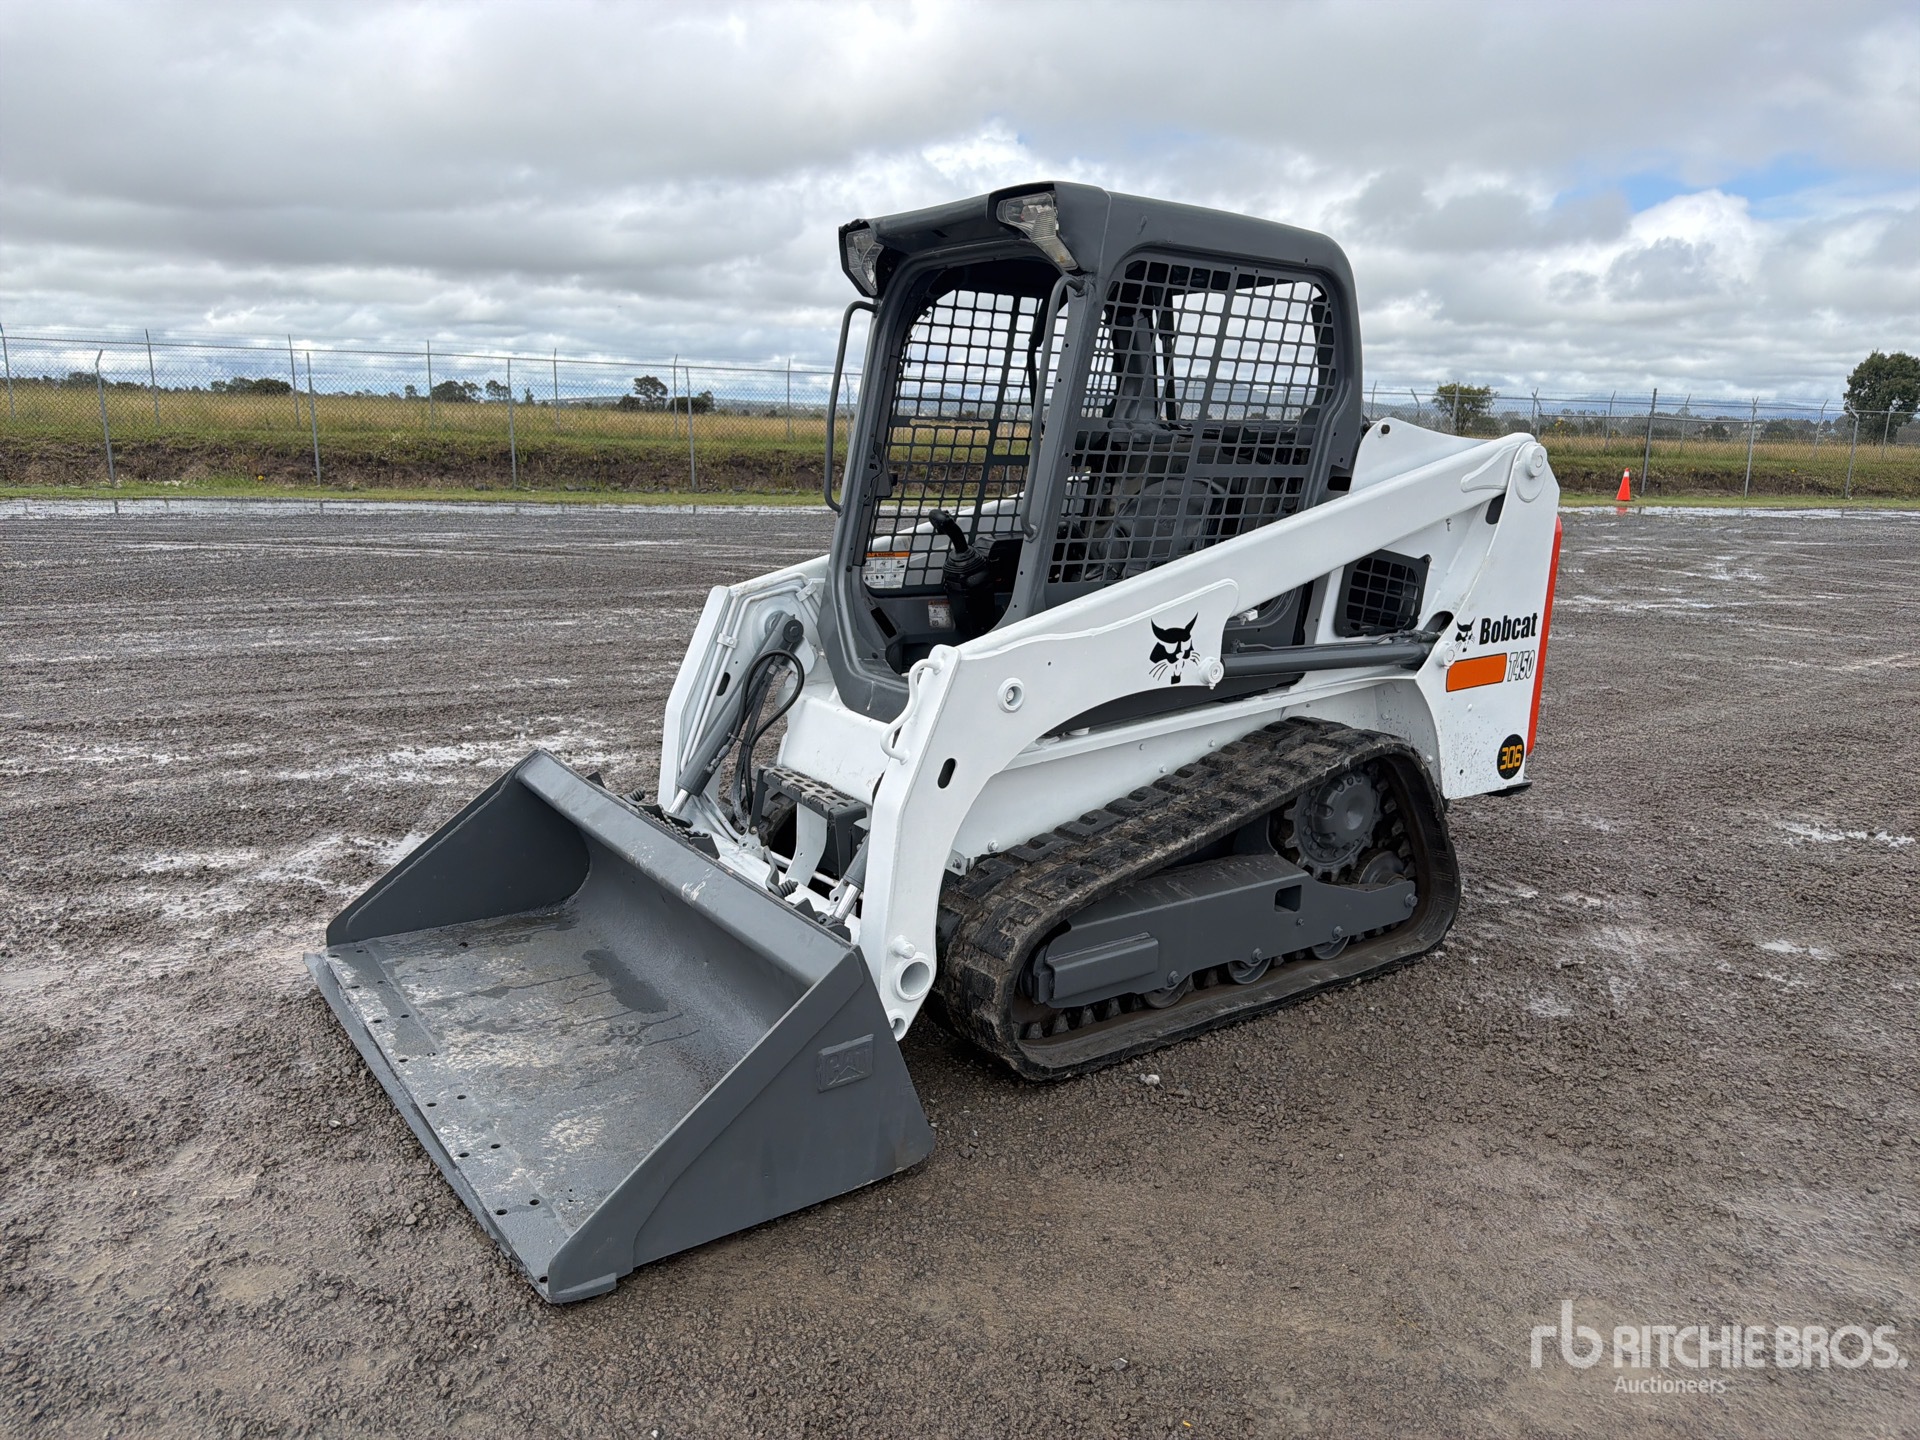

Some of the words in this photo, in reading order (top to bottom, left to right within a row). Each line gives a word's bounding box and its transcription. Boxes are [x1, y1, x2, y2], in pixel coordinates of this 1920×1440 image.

[1479, 612, 1538, 645] Bobcat
[1507, 649, 1535, 682] T450
[1500, 744, 1523, 770] 306
